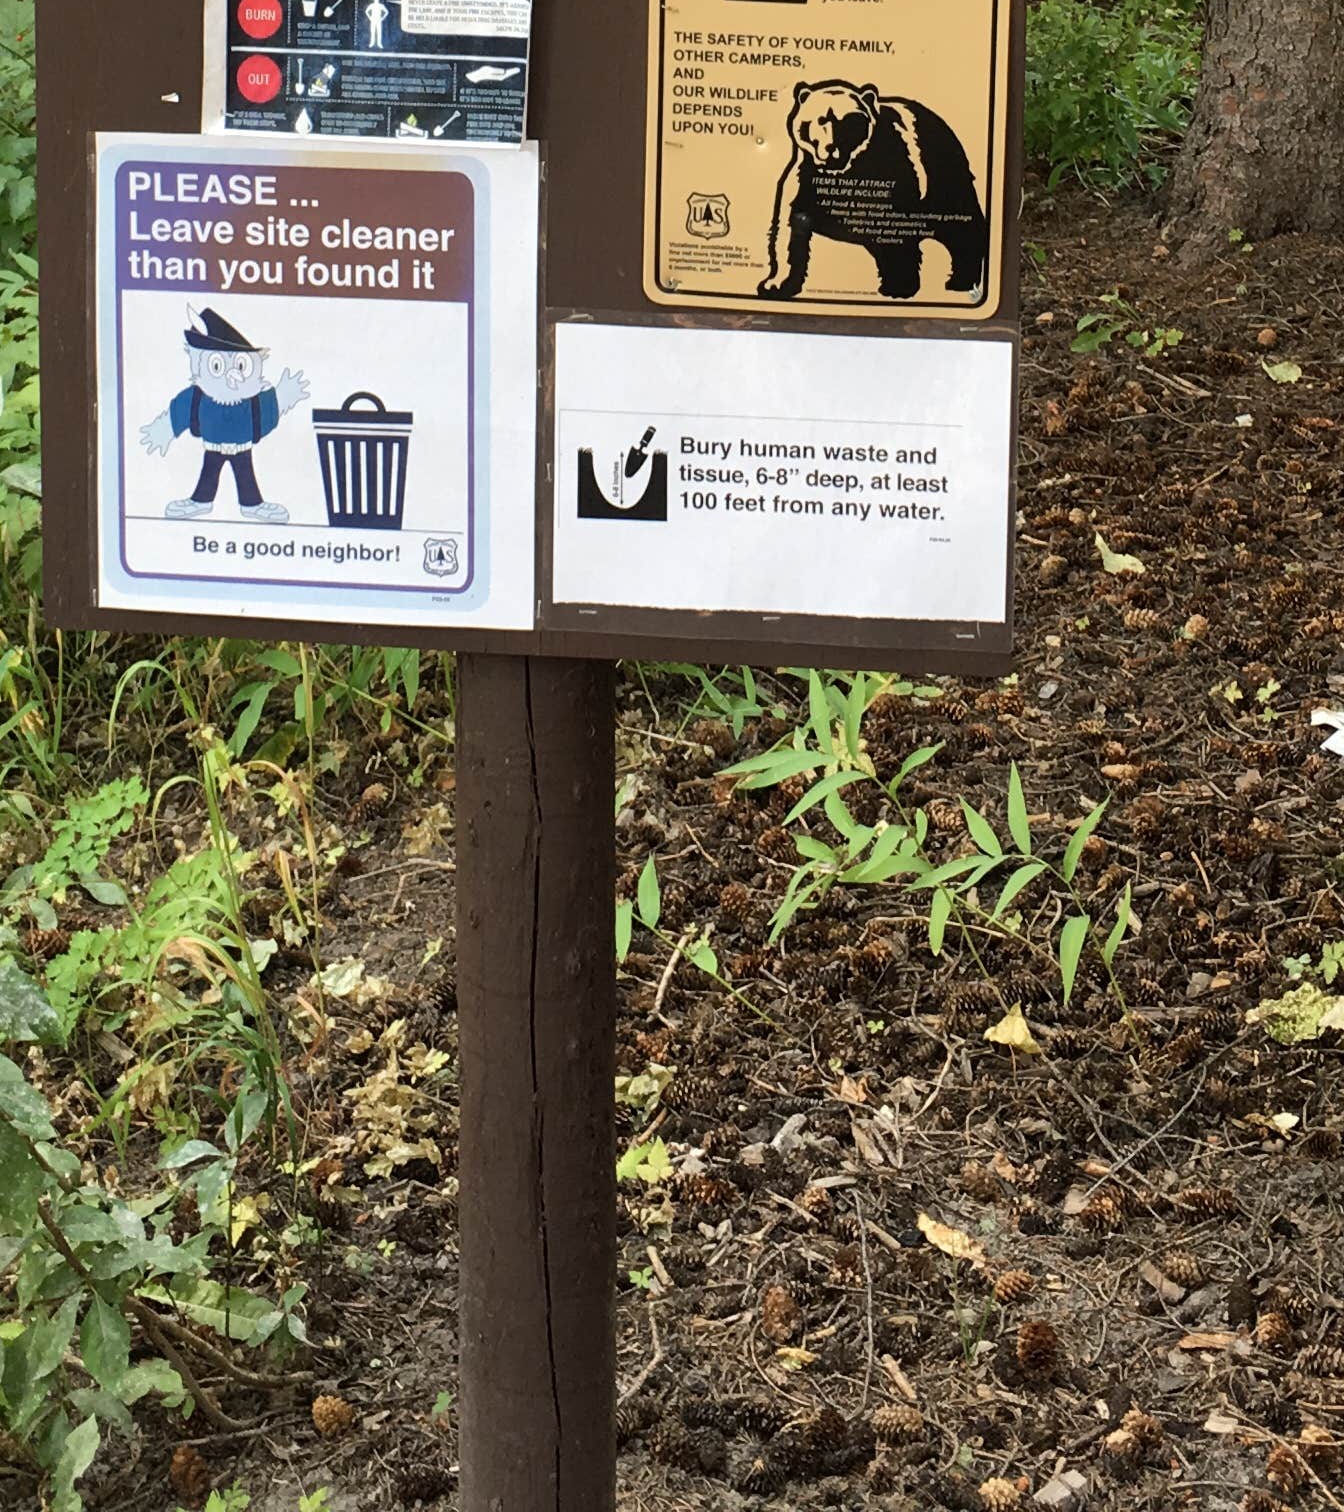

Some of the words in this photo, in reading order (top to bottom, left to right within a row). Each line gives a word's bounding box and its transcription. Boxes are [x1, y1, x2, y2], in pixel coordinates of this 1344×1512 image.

[245, 8, 276, 21] BURN
[673, 30, 702, 44] THE
[706, 32, 764, 47] SAFETY
[768, 36, 788, 48] OF
[792, 37, 835, 51] YOUR
[839, 39, 895, 55] FAMILY,
[673, 48, 724, 63] OTHER
[728, 51, 805, 68] CAMPERS,
[247, 73, 269, 85] OUT
[672, 66, 704, 80] AND
[672, 84, 705, 98] OUR
[709, 86, 777, 102] WILDLIFE
[672, 102, 743, 118] DEPENDS
[671, 120, 713, 134] UPON
[717, 122, 754, 136] YOU!
[128, 171, 277, 205] PLEASE
[849, 200, 855, 208] &
[129, 210, 234, 244] Leave
[245, 215, 309, 247] site
[321, 218, 454, 251] cleaner
[127, 249, 206, 281] than
[218, 259, 282, 289] you
[294, 255, 398, 288] found
[412, 259, 434, 289] it
[680, 436, 732, 460] Bury
[739, 438, 815, 459] human
[822, 444, 888, 462] waste
[895, 446, 936, 465] and
[678, 464, 749, 487] tissue,
[805, 469, 863, 493] deep,
[870, 473, 890, 490] at
[897, 472, 948, 493] least
[679, 491, 717, 510] 100
[724, 492, 765, 512] feet
[772, 494, 823, 514] from
[831, 501, 871, 521] any
[878, 502, 944, 520] water.
[192, 535, 219, 553] Be
[225, 540, 236, 554] a
[243, 540, 294, 559] good
[301, 541, 400, 564] neighbor!
